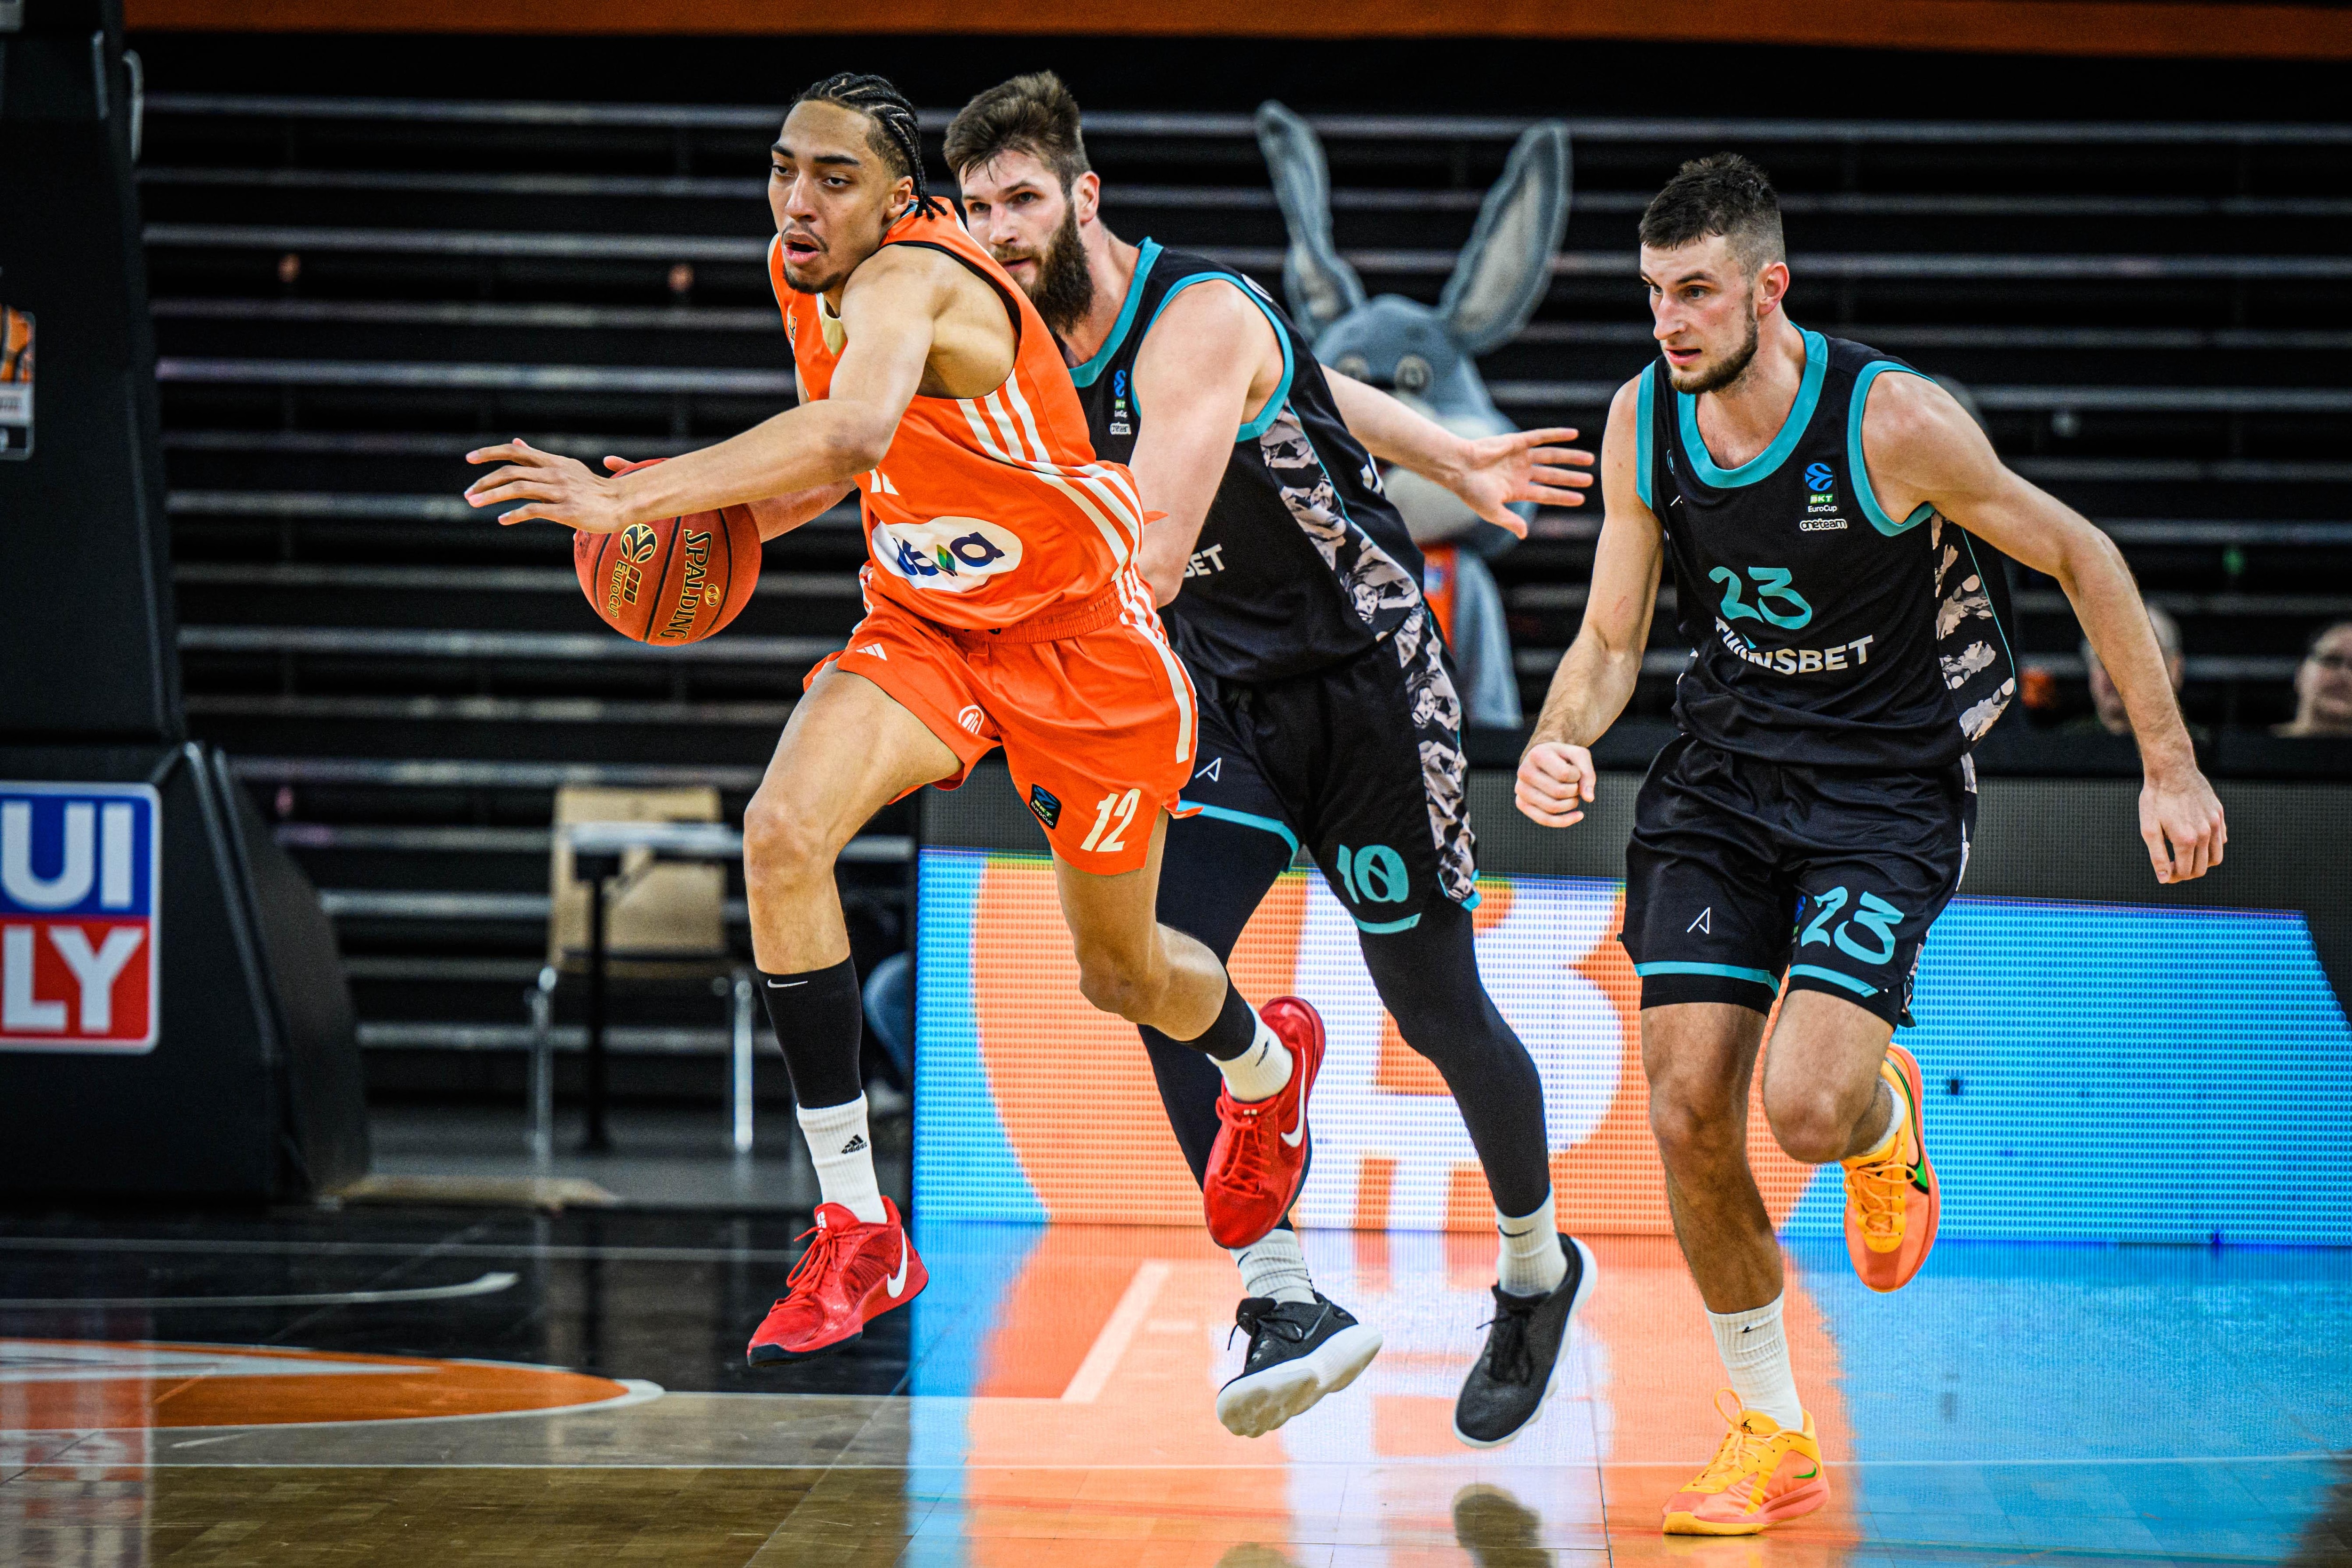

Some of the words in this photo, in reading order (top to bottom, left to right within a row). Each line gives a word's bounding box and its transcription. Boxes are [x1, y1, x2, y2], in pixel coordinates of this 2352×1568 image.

[1800, 519, 1847, 531] oneteam
[1811, 494, 1833, 504] BKT
[607, 560, 628, 618] EuroCup
[660, 529, 712, 639] SPALDING
[1708, 566, 1812, 629] 23
[1031, 801, 1054, 826] EuroCup
[1081, 788, 1141, 852] 12
[1336, 845, 1409, 904] 10
[1801, 886, 1904, 965] 23
